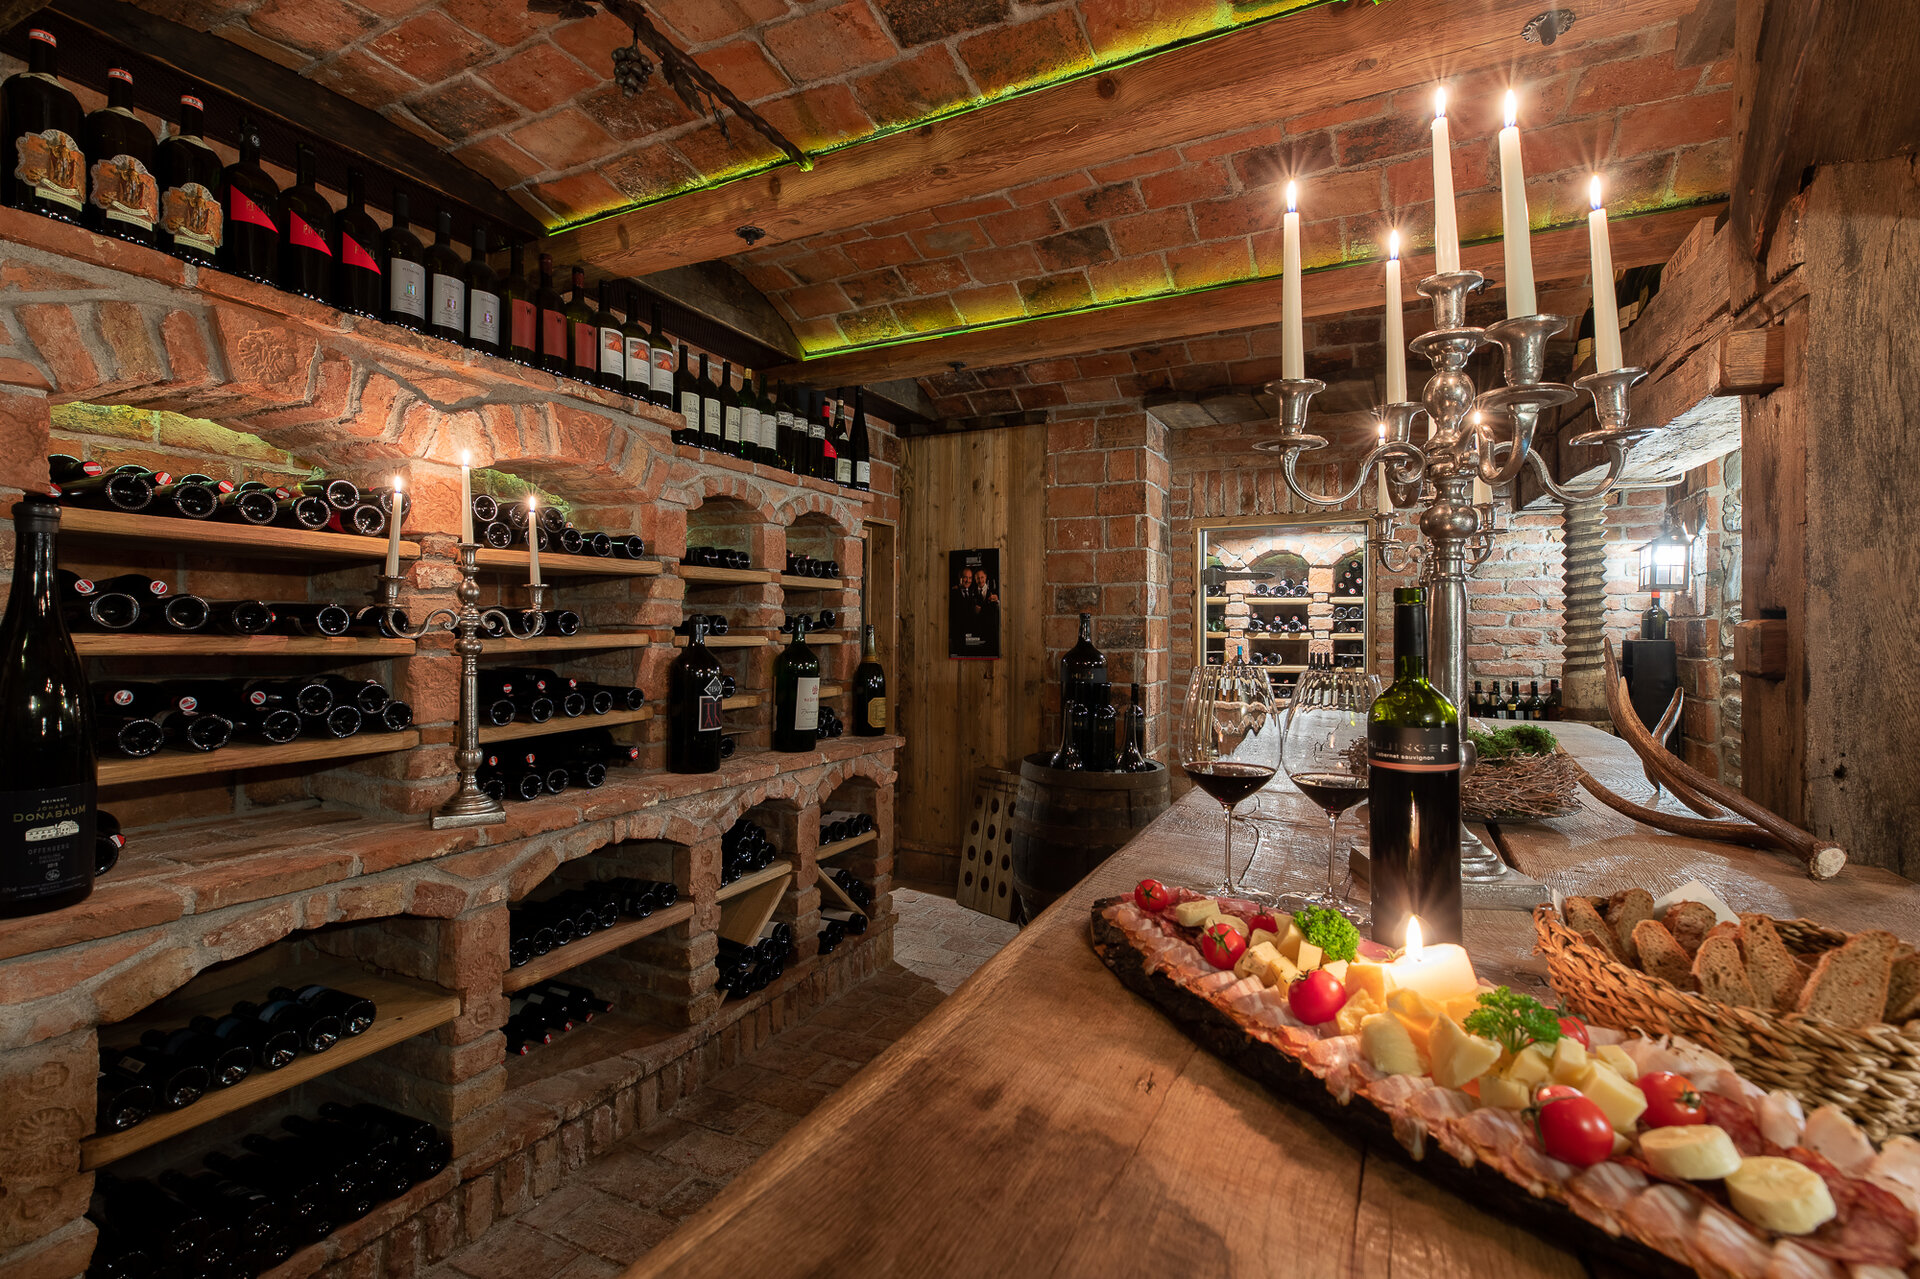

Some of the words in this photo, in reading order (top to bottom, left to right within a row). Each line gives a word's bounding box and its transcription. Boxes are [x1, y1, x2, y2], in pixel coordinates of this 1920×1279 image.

[1375, 752, 1400, 760] cabernet
[1401, 753, 1436, 762] sauvignon
[37, 802, 70, 813] JOHANN
[13, 805, 86, 823] DONABAUM
